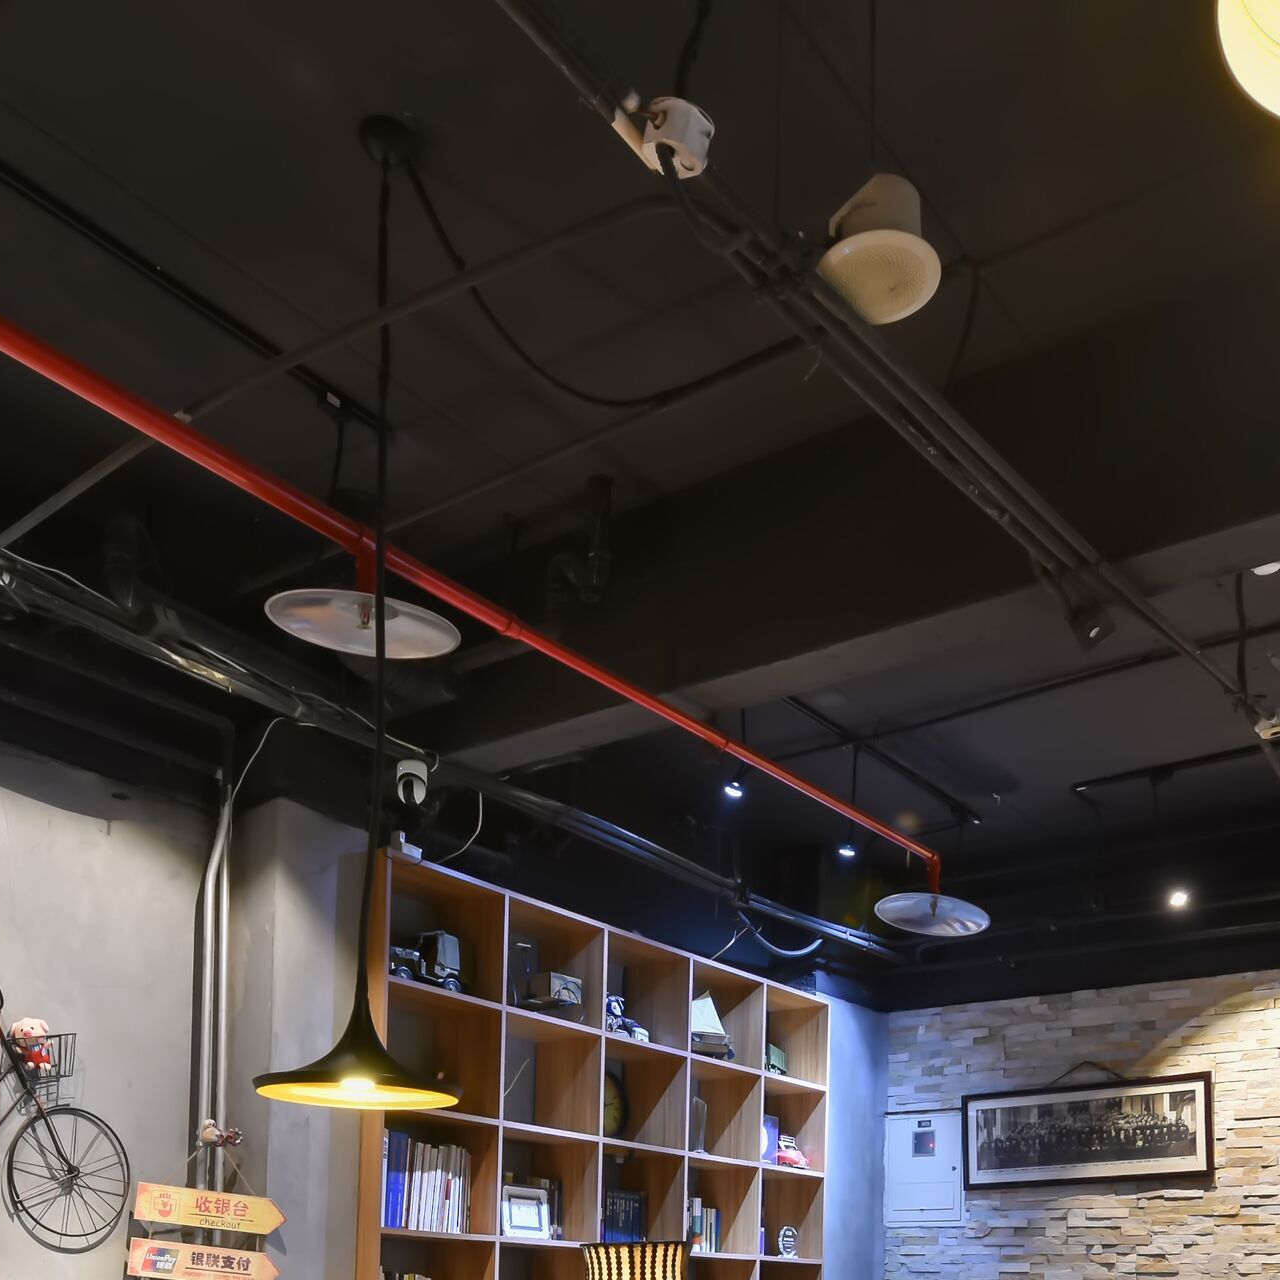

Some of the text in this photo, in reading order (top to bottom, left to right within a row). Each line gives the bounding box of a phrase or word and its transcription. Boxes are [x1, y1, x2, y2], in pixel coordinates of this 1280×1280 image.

[195, 1195, 250, 1218] 收银台
[199, 1217, 241, 1229] checkout
[190, 1251, 252, 1272] 银联支付
